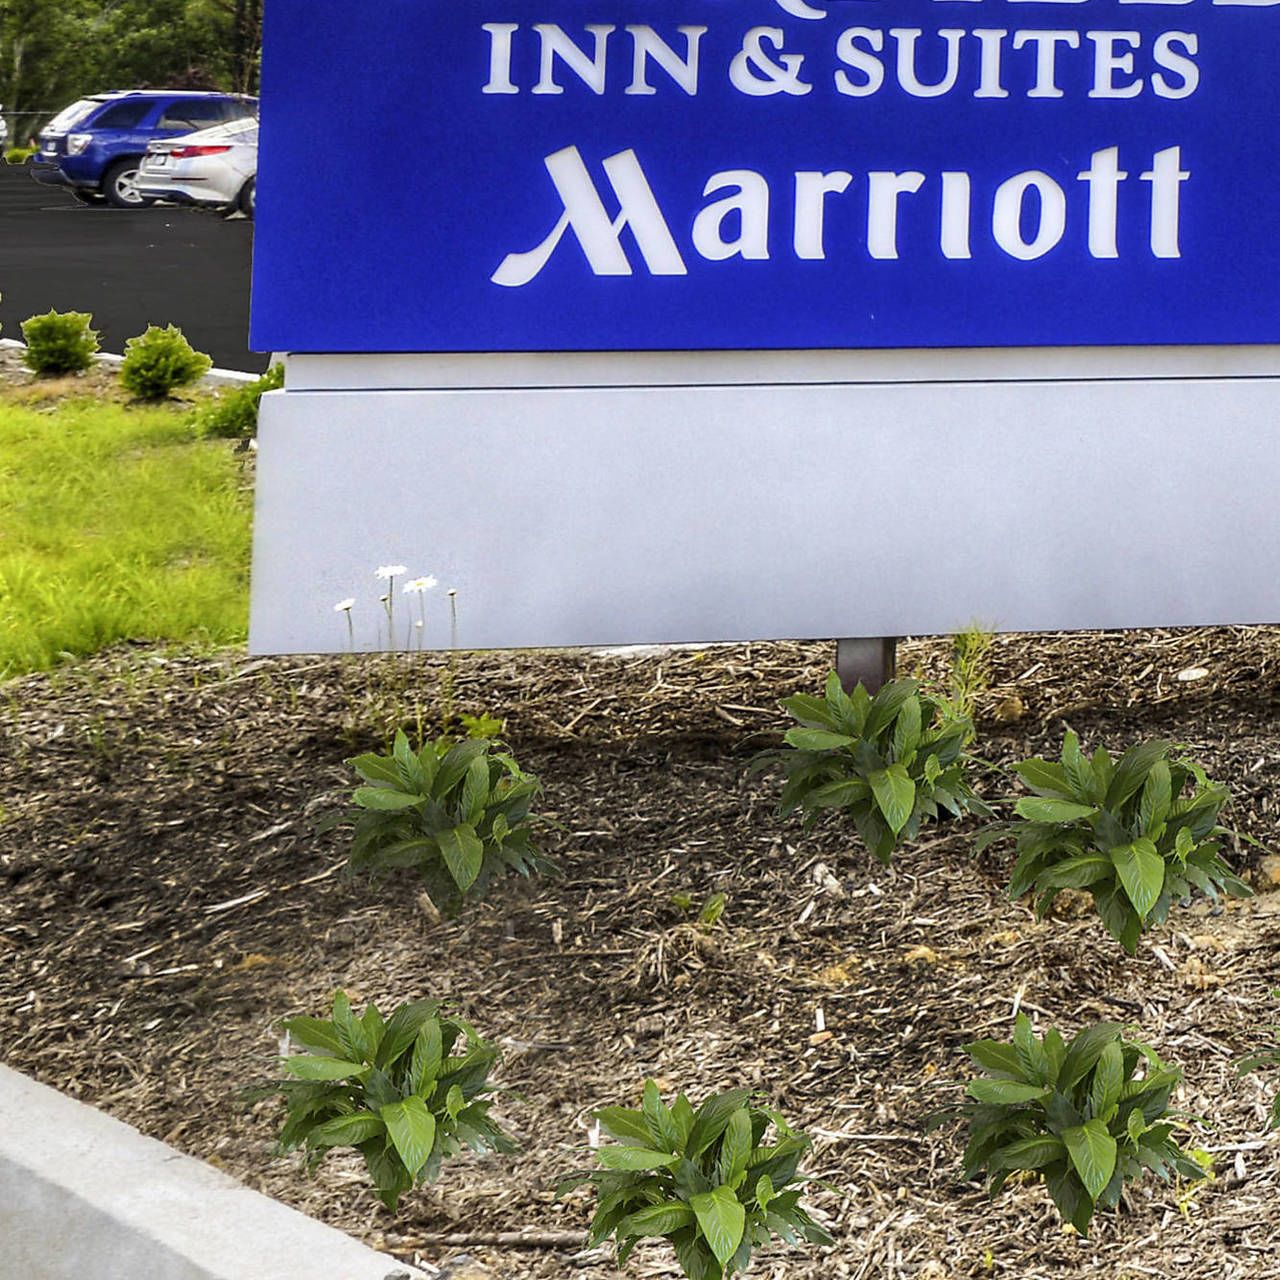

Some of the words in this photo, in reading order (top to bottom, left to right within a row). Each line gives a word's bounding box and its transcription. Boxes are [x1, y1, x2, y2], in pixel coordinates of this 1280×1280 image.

[481, 23, 708, 96] INN
[729, 26, 813, 97] &
[834, 26, 1200, 100] SUITES
[490, 145, 1191, 287] Marriott
